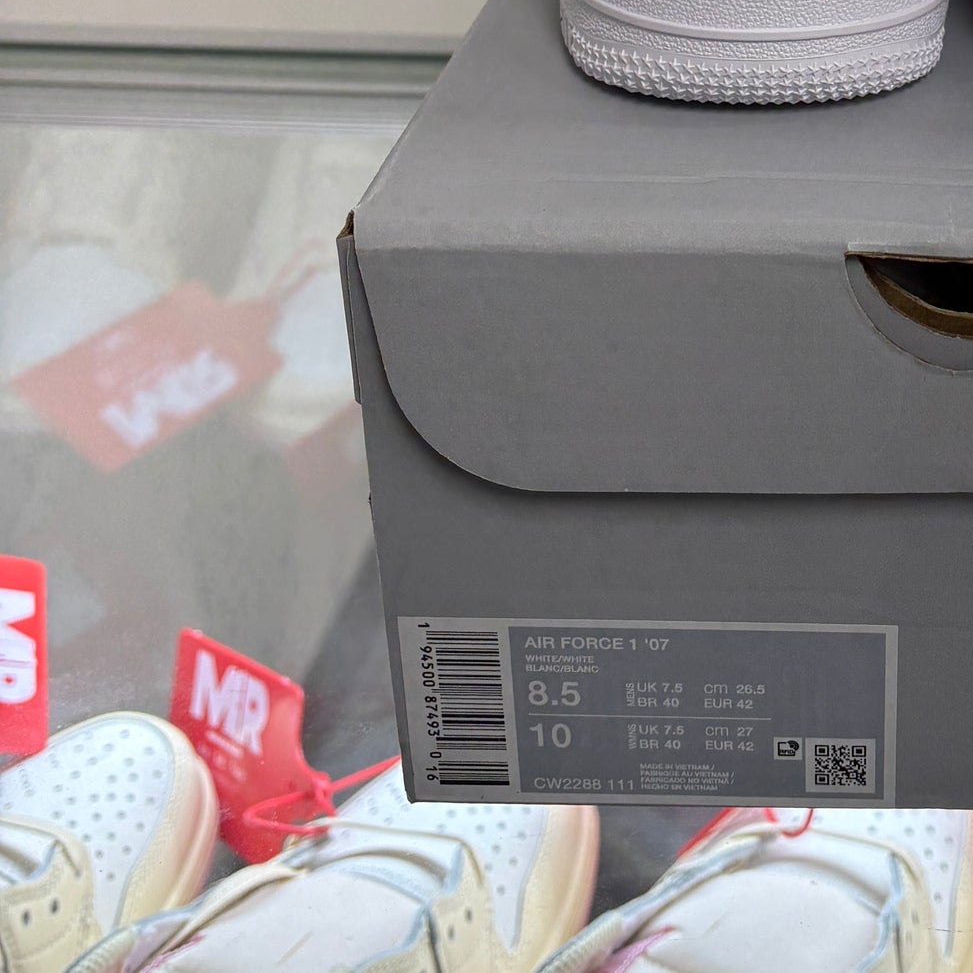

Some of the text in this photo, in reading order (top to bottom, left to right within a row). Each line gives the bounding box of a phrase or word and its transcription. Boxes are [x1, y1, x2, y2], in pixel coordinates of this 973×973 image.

[524, 636, 669, 651] AIR FORCE 1 '07
[525, 654, 594, 663] WHITE/WHITE
[419, 645, 436, 687] 94500
[525, 664, 599, 673] BLANC/BLANC
[528, 680, 581, 707] 8.5
[637, 682, 683, 694] UK 7.5
[736, 684, 765, 695] 26.5
[625, 682, 636, 707] MENS
[189, 648, 270, 756] MR
[637, 697, 680, 708] BR 40
[704, 698, 753, 710] EUR 42
[424, 695, 440, 736] 87493
[529, 723, 572, 748] 10
[639, 725, 685, 736] UK 7.5
[737, 726, 754, 738] 27
[639, 739, 681, 750] BR 40
[705, 740, 754, 752] EUR 42
[429, 751, 442, 759] 0
[425, 765, 439, 781] 16
[534, 778, 634, 791] CW2288 111
